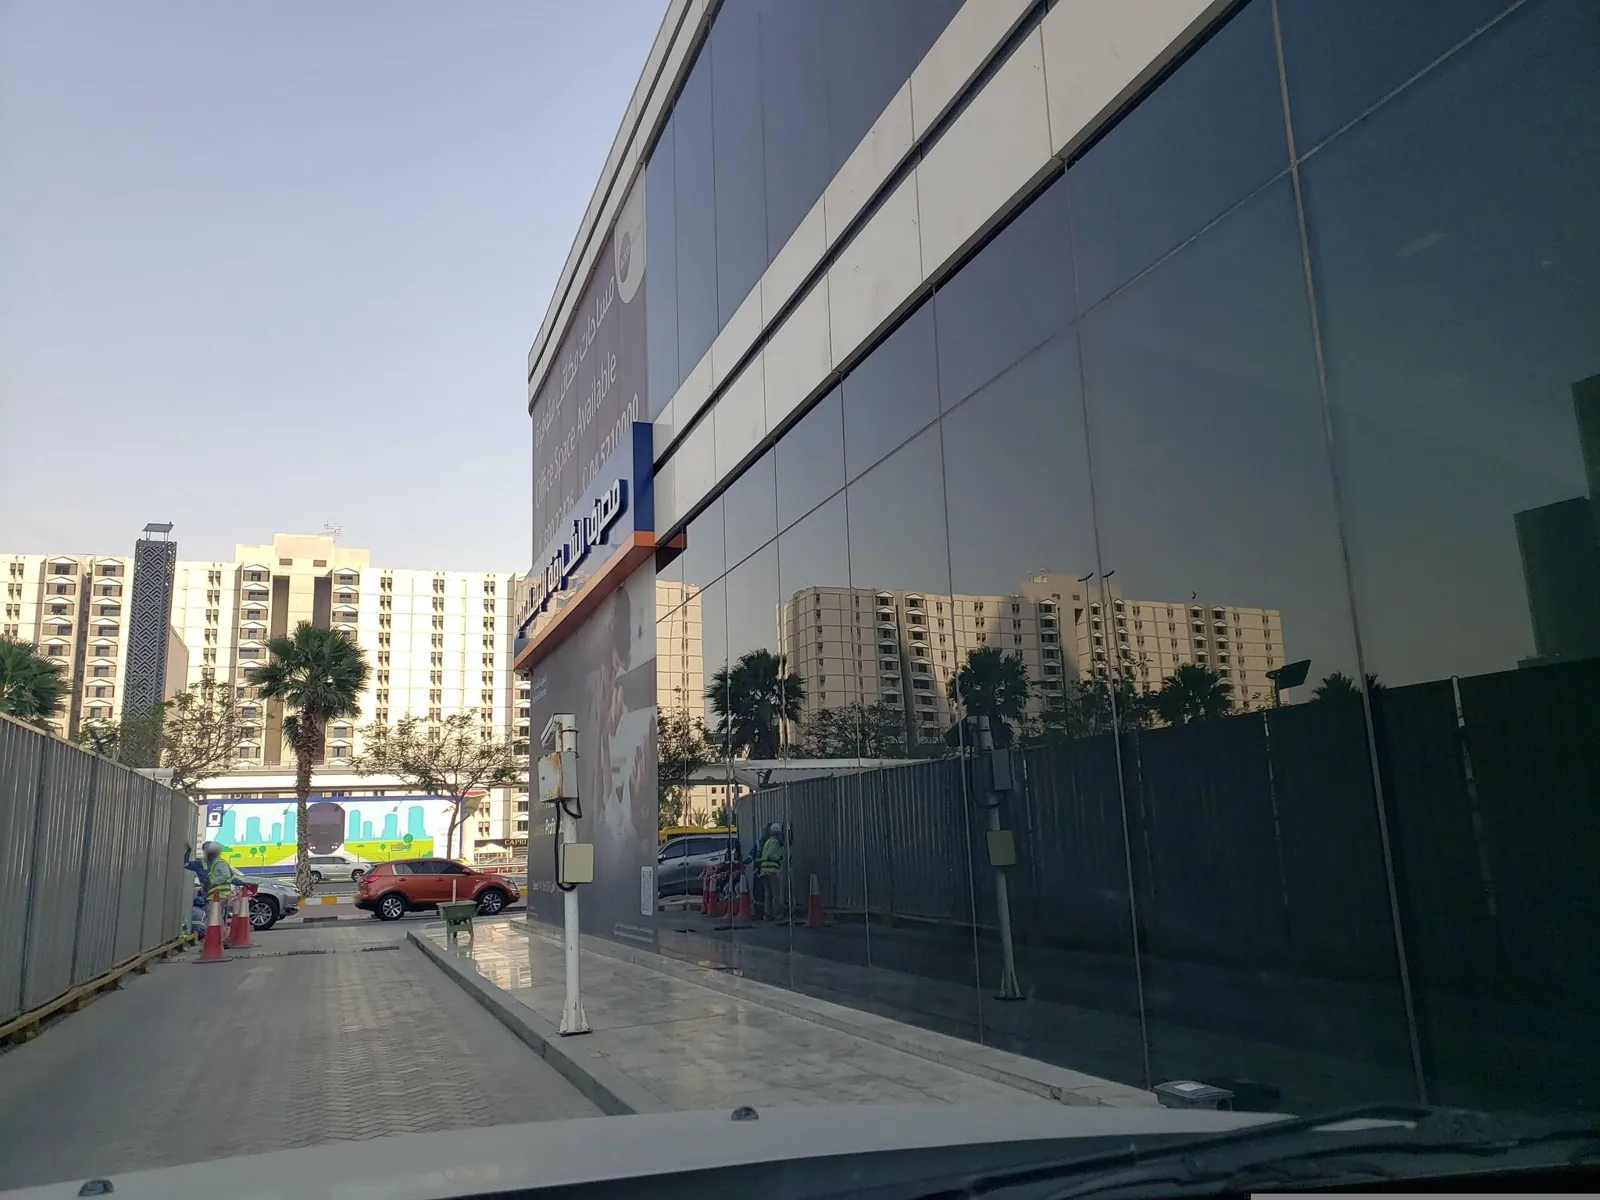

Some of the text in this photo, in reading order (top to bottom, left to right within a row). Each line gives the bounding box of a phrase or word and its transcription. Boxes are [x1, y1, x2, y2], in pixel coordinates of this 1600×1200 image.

[536, 351, 617, 508] Office Space Available
